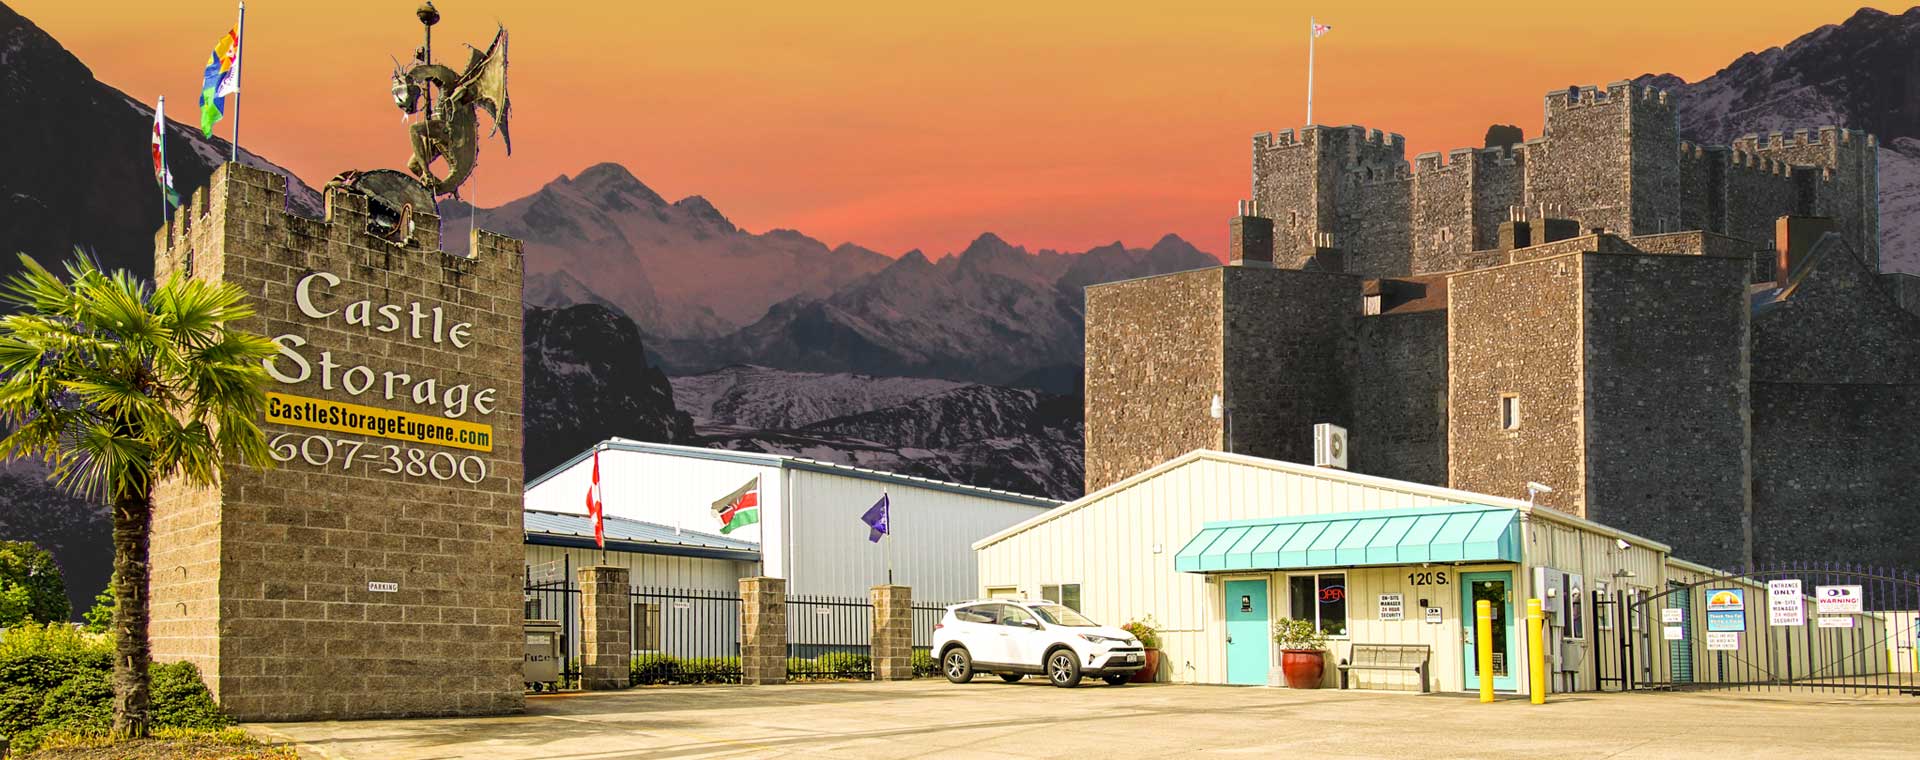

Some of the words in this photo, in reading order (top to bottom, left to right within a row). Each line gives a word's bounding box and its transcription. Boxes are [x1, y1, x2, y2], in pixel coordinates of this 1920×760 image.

[296, 272, 472, 348] Castle
[262, 334, 497, 419] Storage
[269, 397, 490, 447] CastleStorageEugene.com
[268, 432, 487, 484] 607-3800
[370, 583, 397, 591] PARKING
[1319, 589, 1345, 600] OPEN
[1408, 572, 1433, 586] 120
[1436, 571, 1449, 585] S.
